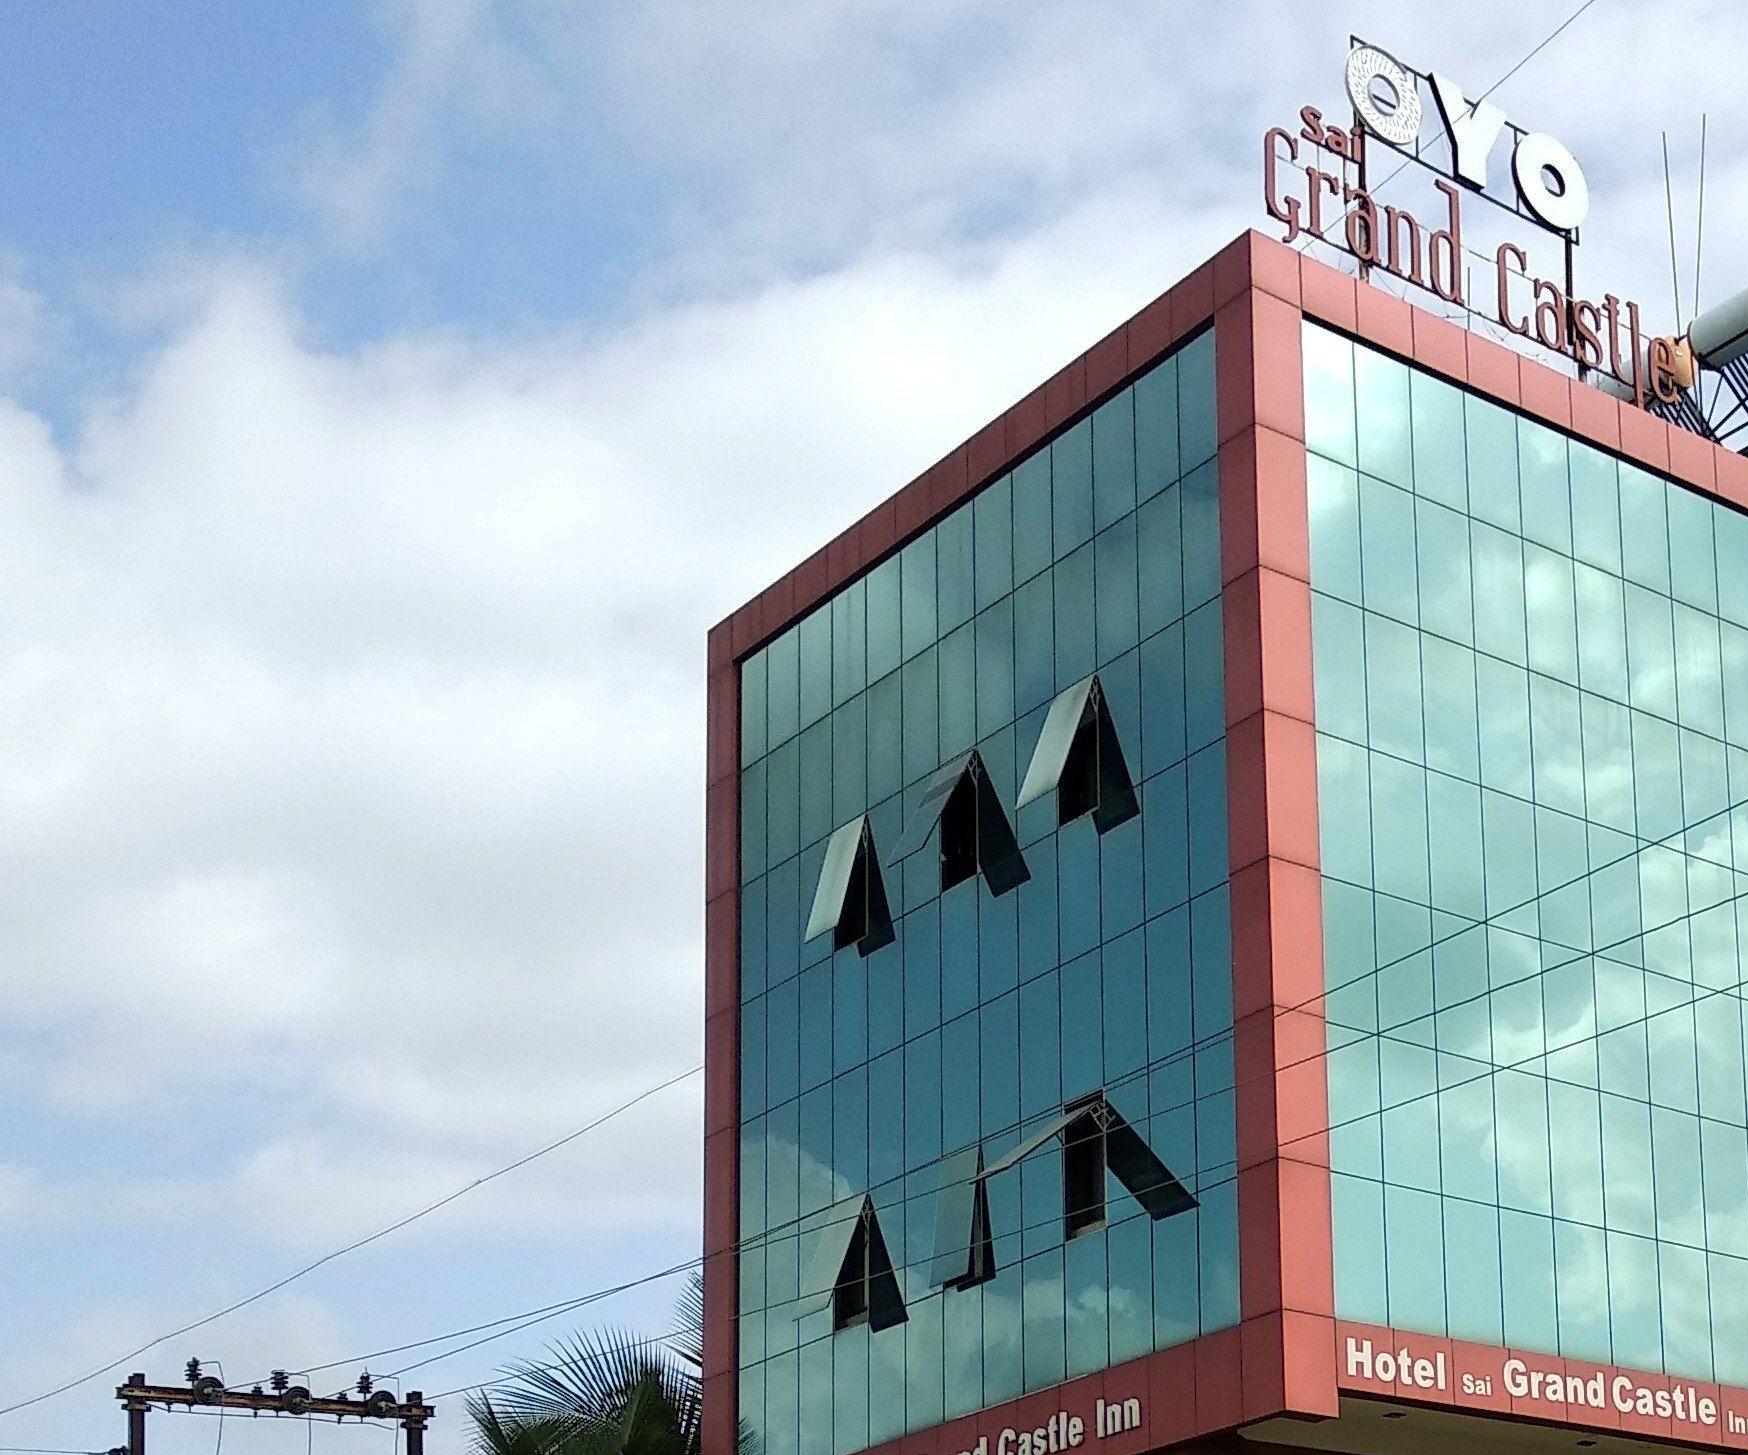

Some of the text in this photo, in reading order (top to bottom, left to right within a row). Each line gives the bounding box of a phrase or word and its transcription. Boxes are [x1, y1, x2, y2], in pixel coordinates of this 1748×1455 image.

[1300, 105, 1363, 164] Sai
[1345, 44, 1590, 230] OYO
[1264, 127, 1681, 406] Grand Castle
[1096, 1396, 1141, 1438] Inn
[1346, 1337, 1447, 1391] Hotel
[1462, 1372, 1492, 1397] Sai
[1503, 1358, 1605, 1409] Grand
[1612, 1374, 1717, 1425] Castle
